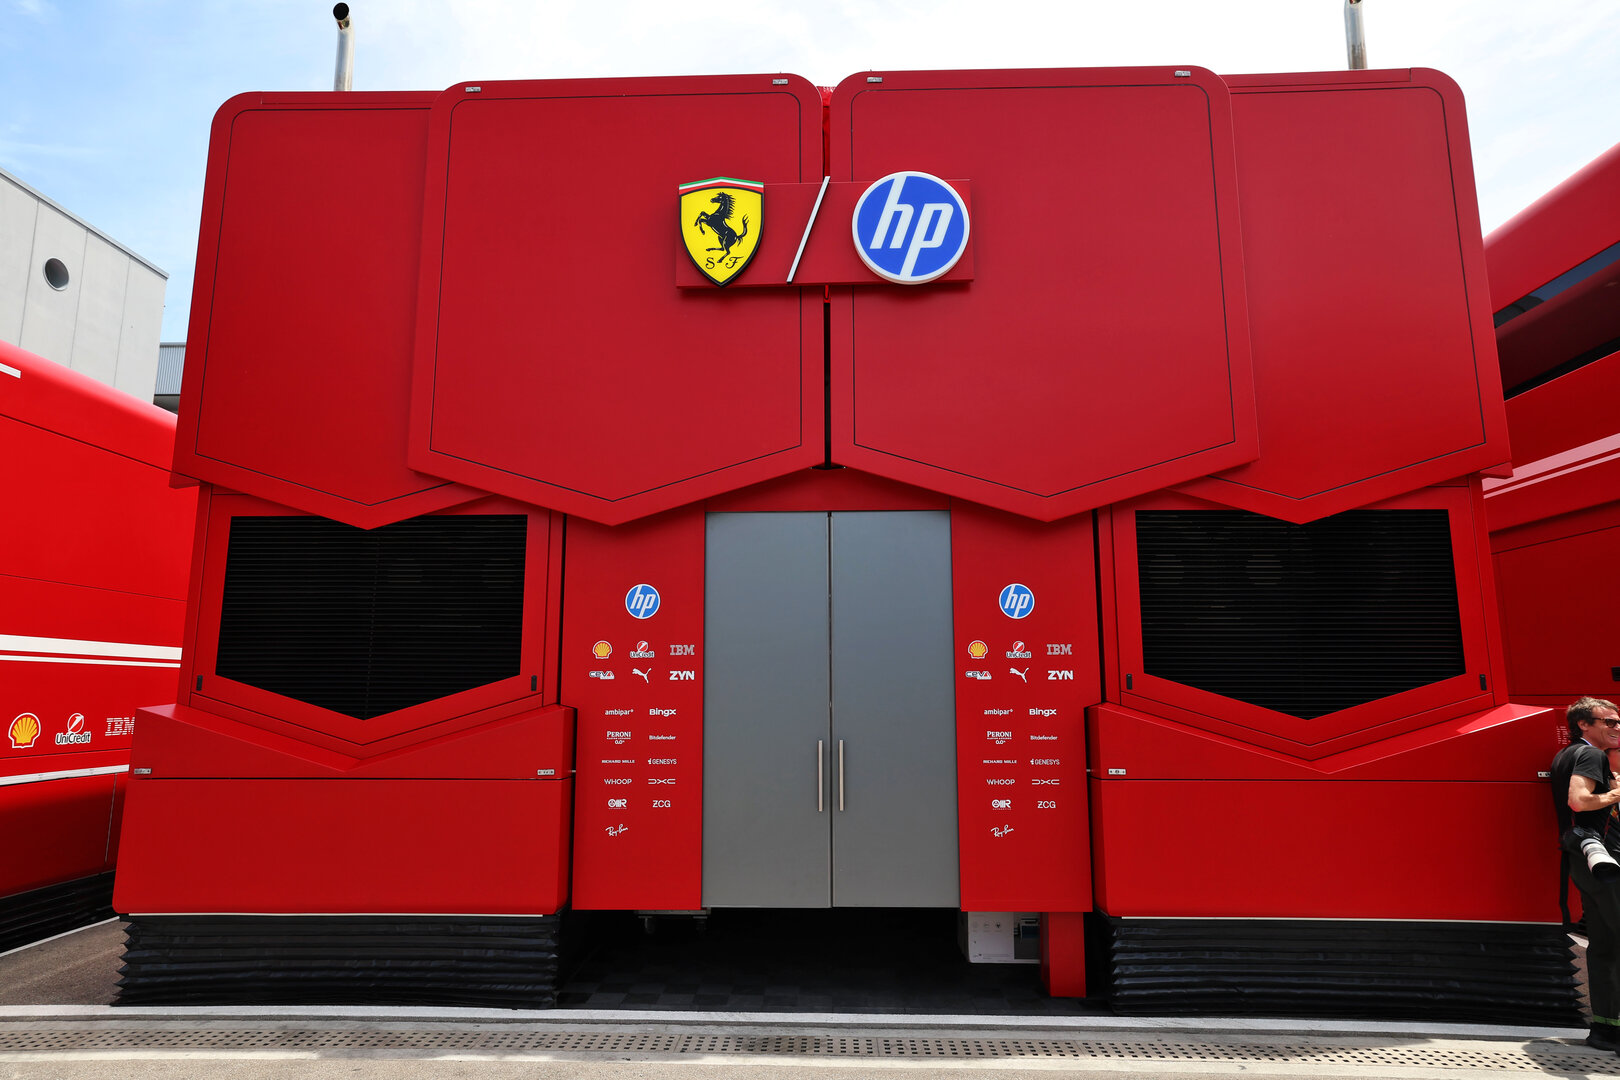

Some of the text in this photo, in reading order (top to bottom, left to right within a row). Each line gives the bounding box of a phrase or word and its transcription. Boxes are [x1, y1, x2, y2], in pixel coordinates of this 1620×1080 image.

[869, 175, 954, 277] hp
[705, 257, 716, 270] S
[630, 585, 657, 618] hp
[1004, 584, 1031, 618] hp
[669, 644, 695, 656] IBM
[1046, 643, 1073, 655] IBM
[630, 651, 655, 659] UniCredit
[1006, 651, 1032, 659] UniCredit
[669, 670, 695, 681] ZYN
[1047, 670, 1074, 681] ZYN
[104, 716, 136, 737] IBM
[55, 731, 92, 746] UniCredit
[606, 730, 632, 738] PERONI
[986, 730, 1012, 738] PERONI
[1034, 758, 1060, 766] GENESYS
[986, 778, 1016, 786] WHOOP
[652, 800, 671, 808] ZCG
[1037, 800, 1057, 809] ZCG
